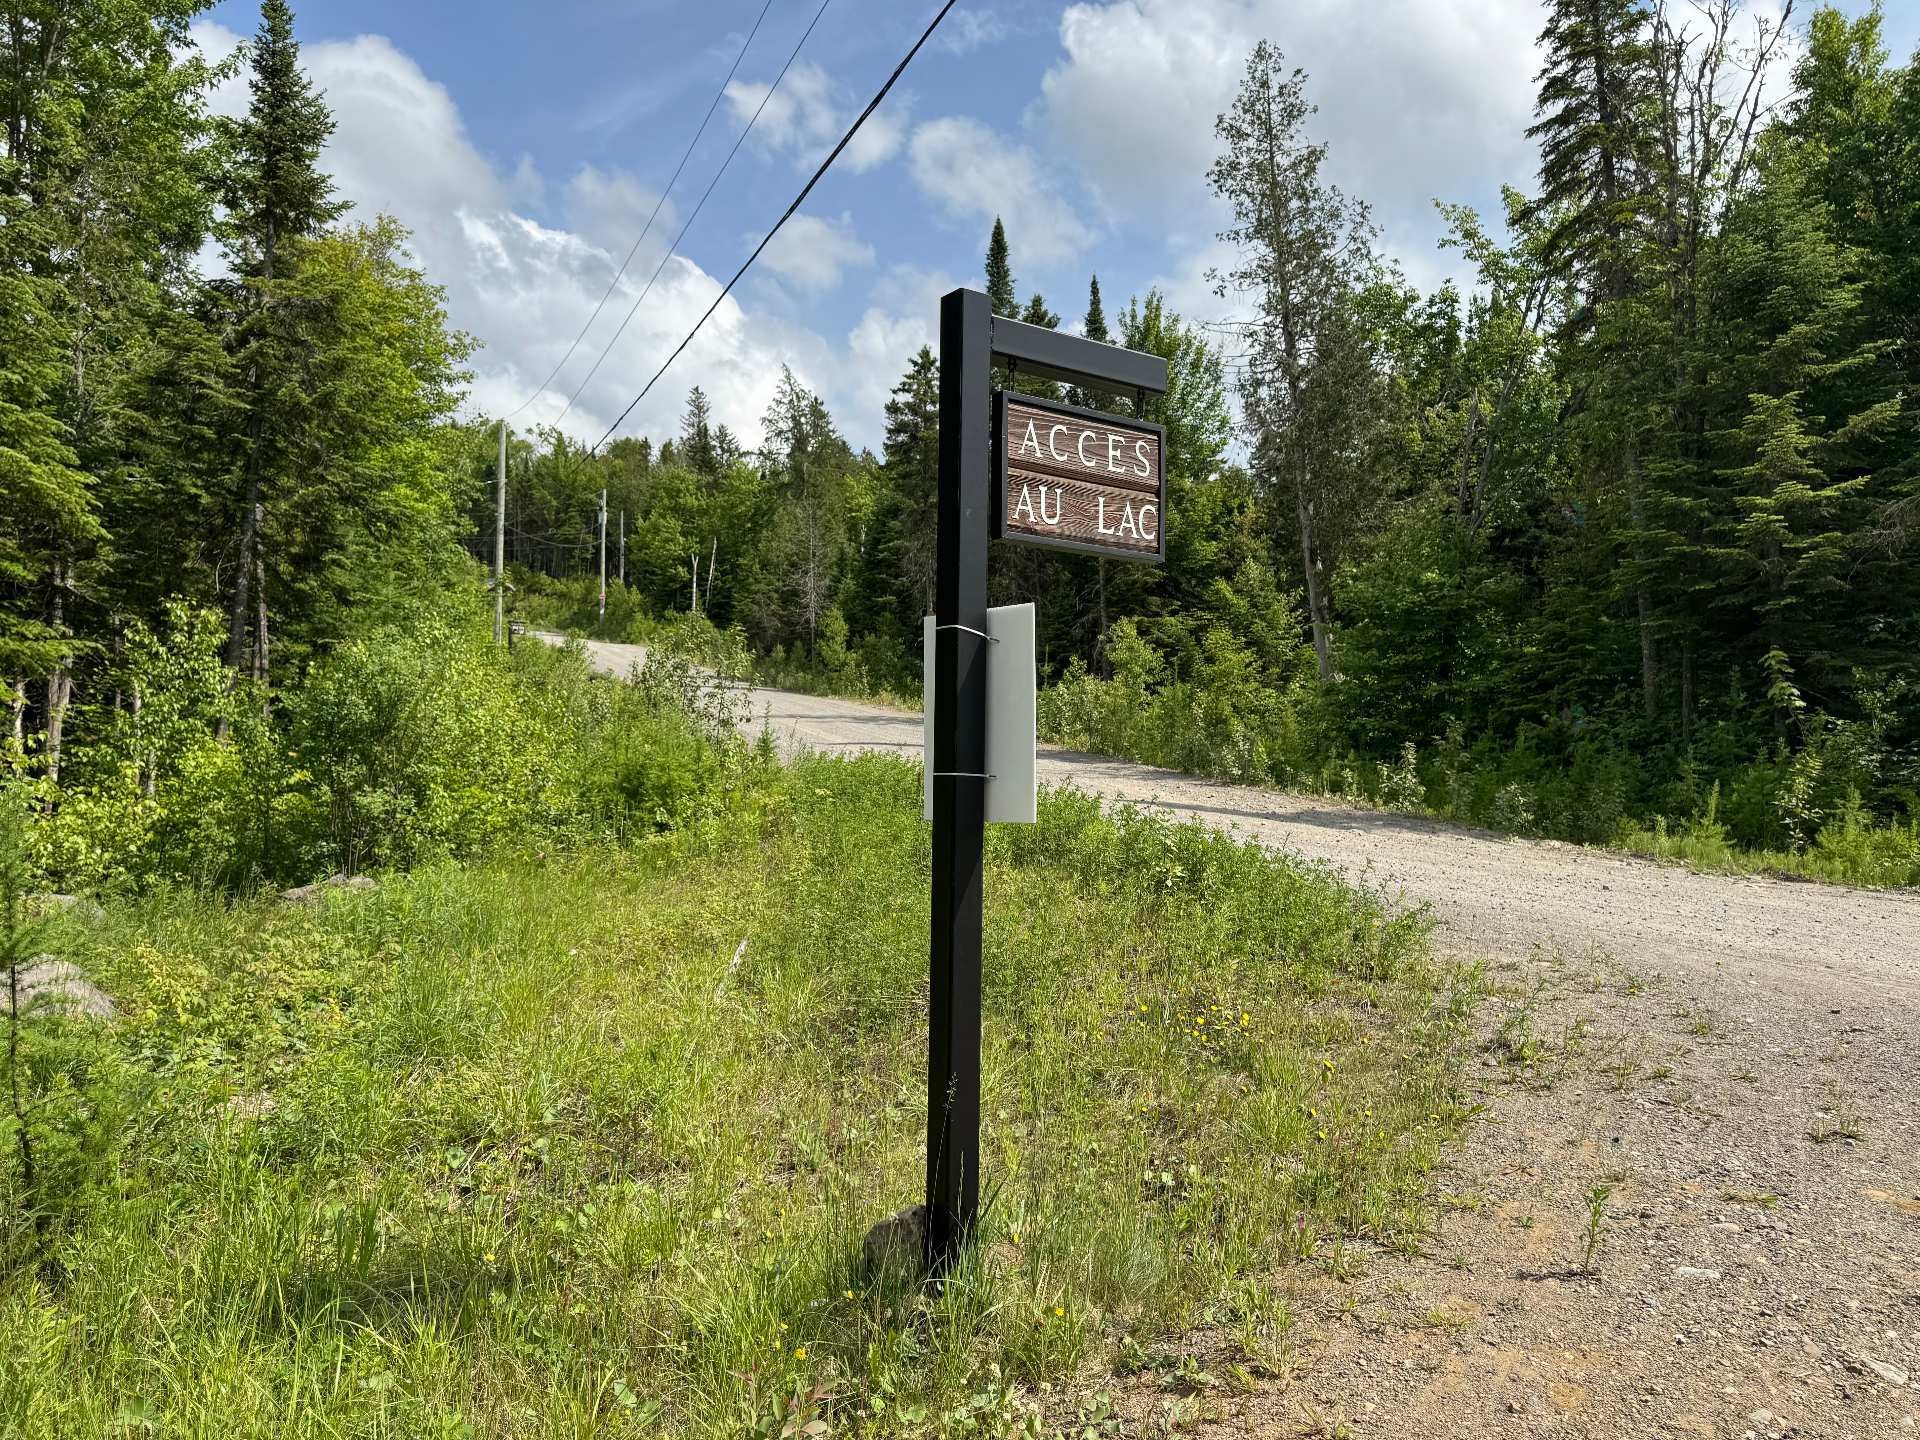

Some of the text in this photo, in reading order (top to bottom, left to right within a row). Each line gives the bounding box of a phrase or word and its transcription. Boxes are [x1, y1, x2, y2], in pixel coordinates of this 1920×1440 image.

[1017, 417, 1151, 477] ACCES
[1011, 482, 1157, 540] AU LAC
